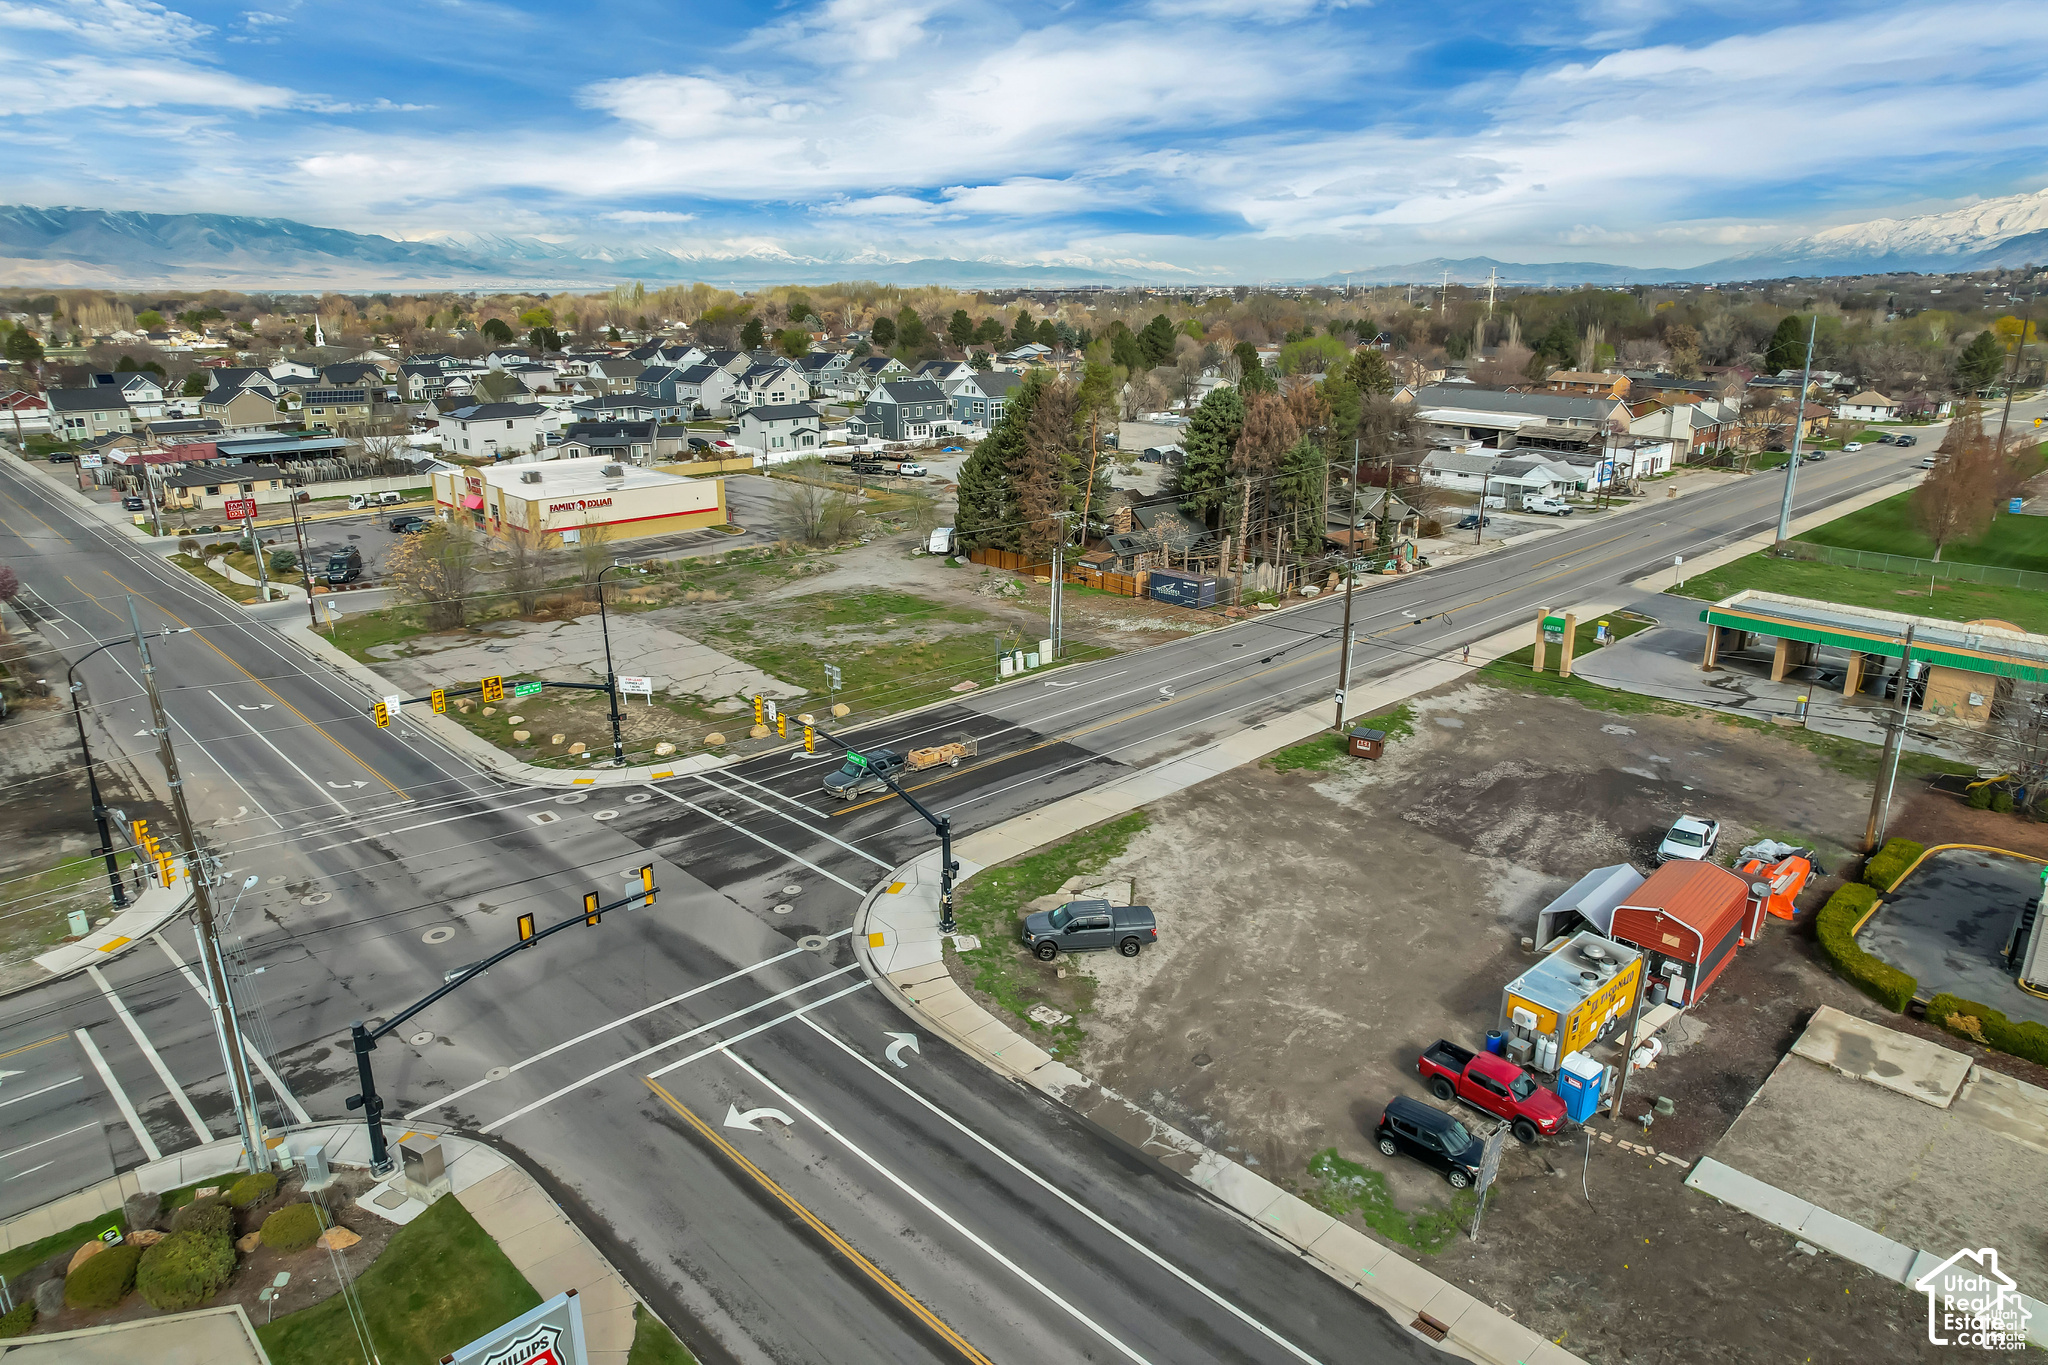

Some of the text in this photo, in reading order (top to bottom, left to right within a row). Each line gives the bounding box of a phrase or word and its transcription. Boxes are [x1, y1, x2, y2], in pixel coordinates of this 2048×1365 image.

[228, 501, 253, 511] FAMLY
[549, 497, 612, 512] FAMILY DOLLAR
